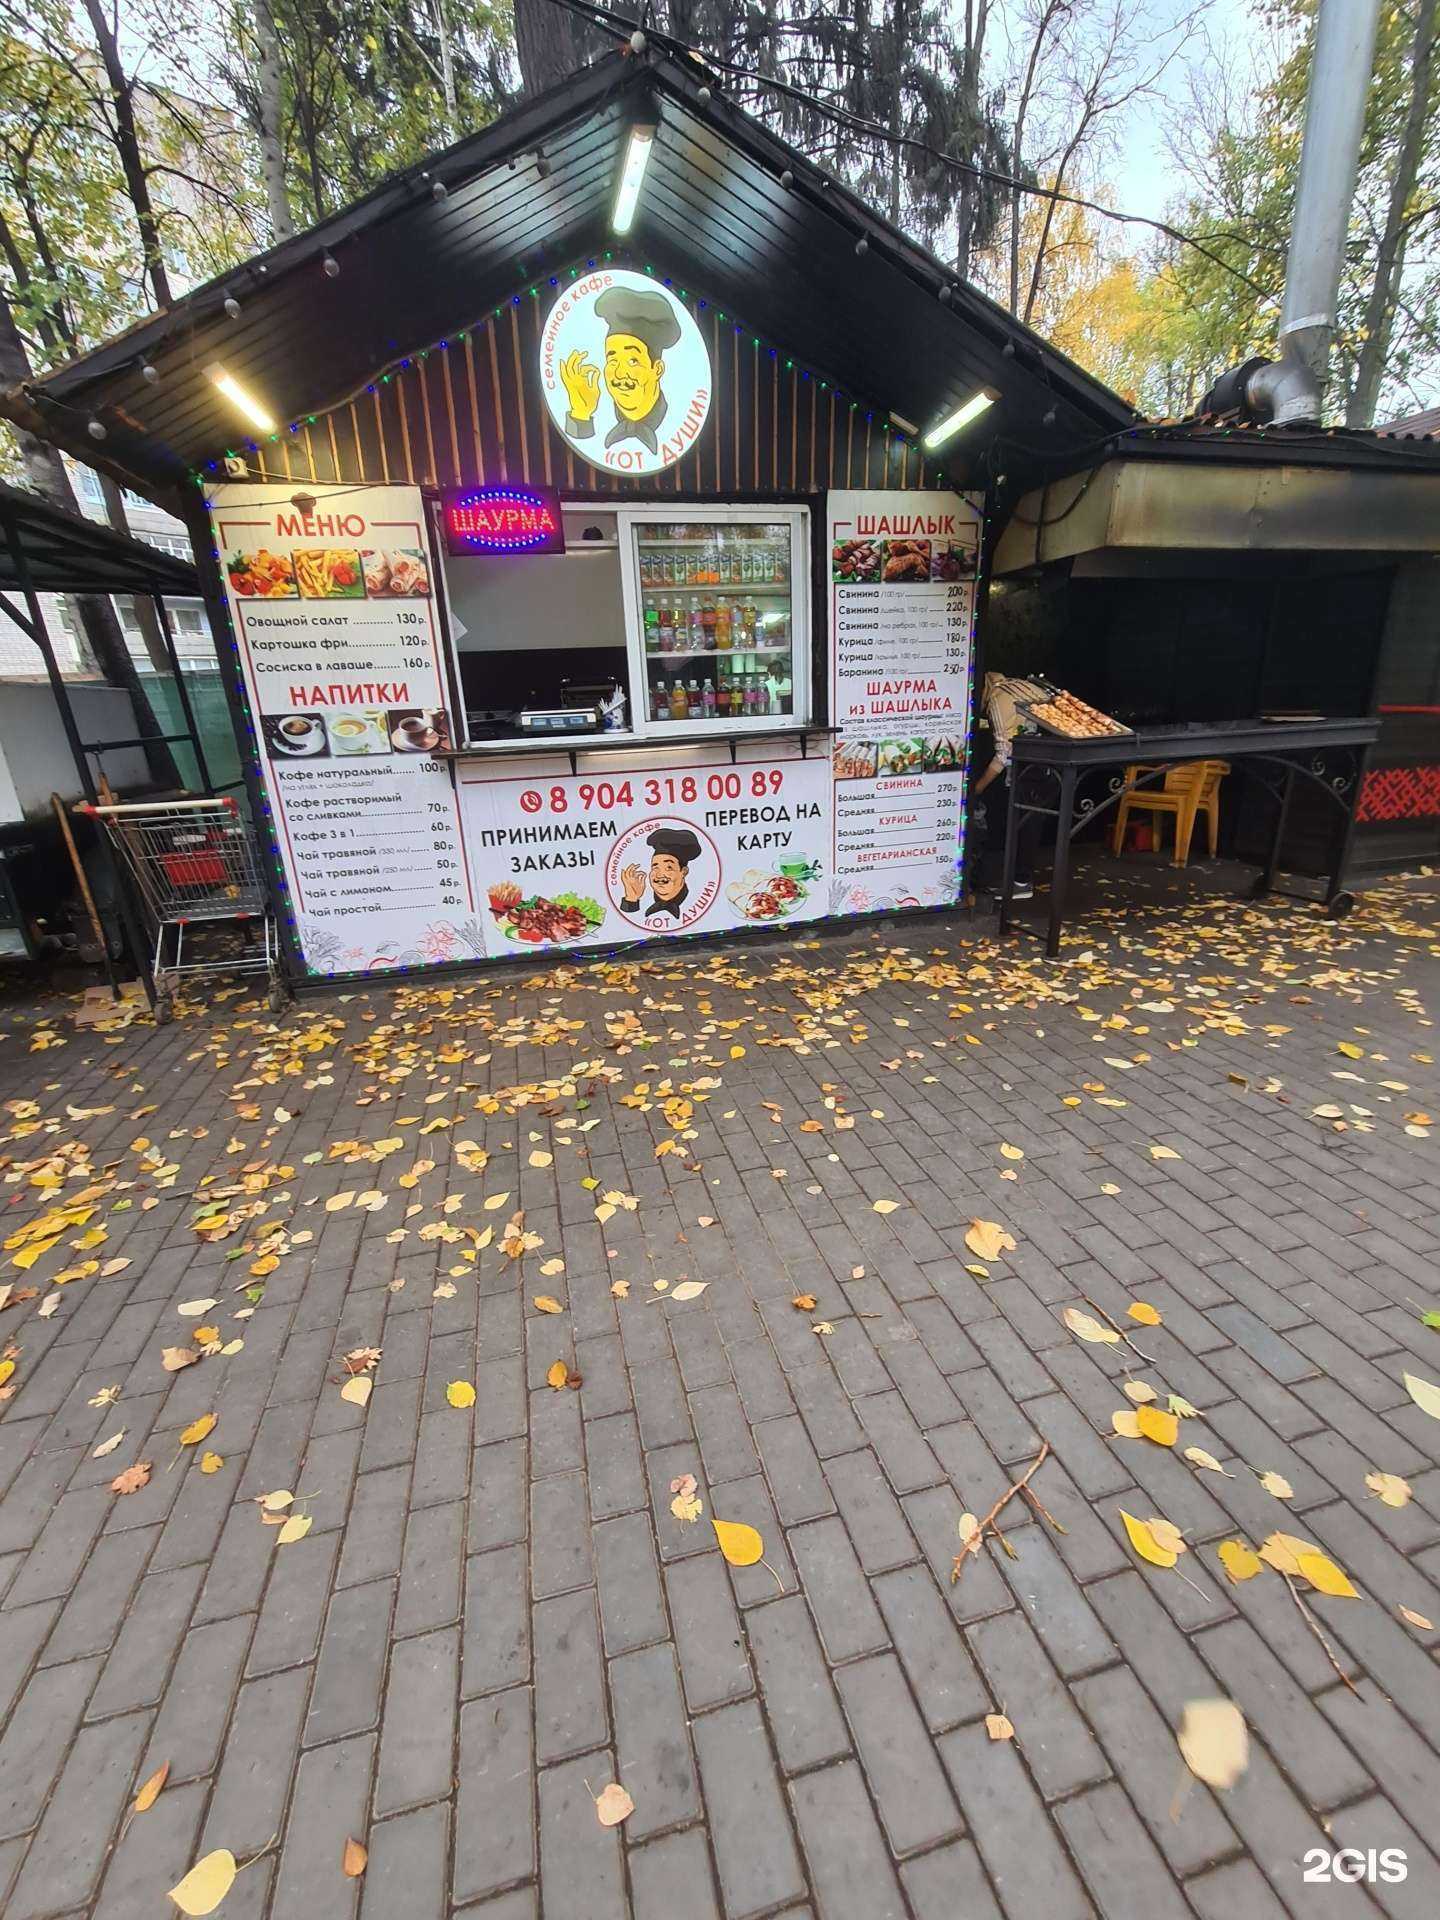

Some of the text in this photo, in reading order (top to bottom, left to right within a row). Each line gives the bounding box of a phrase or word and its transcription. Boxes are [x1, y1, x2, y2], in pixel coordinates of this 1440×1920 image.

[545, 275, 613, 389] семейное кафе
[277, 514, 364, 536] МЕНЮ
[453, 508, 554, 532] ШАУРМА
[858, 515, 954, 535] ШАШЛЫК
[838, 590, 879, 599] Свинина
[838, 606, 879, 614] Свинина
[247, 616, 308, 628] Овощной
[312, 616, 348, 625] салат
[838, 622, 878, 631] Свинина
[251, 640, 316, 652] Картошка
[321, 638, 348, 650] фри
[838, 638, 873, 647] Курица
[838, 654, 872, 663] Курица
[256, 662, 311, 672] Сосиска
[316, 663, 322, 671] в
[326, 660, 373, 671] лаваше
[838, 669, 883, 678] Баранина
[290, 682, 409, 706] НАПИТКИ
[867, 679, 936, 696] ШАУРМА
[871, 697, 952, 714] ШАШЛЫКА
[278, 770, 313, 781] Кофе
[317, 767, 392, 779] натуральный
[550, 770, 783, 813] 8 904 318 00 89
[876, 779, 923, 790] СВИНИНА
[286, 794, 402, 809] Кофе растворимый
[838, 794, 875, 802] Большая
[289, 814, 303, 822] со
[307, 810, 361, 821] сливками
[705, 803, 821, 827] ПЕРЕВОД НА
[838, 808, 875, 818] Средняя
[880, 815, 918, 825] КУРИЦА
[293, 830, 327, 842] Кофе
[330, 830, 336, 838] 3
[350, 829, 355, 837] 1
[481, 820, 617, 847] ПРИНИМАЕМ
[633, 822, 660, 838] кафе
[838, 829, 874, 837] Большая
[737, 832, 792, 851] КАРТУ
[838, 843, 874, 852] Средняя
[297, 850, 319, 861] Чай
[322, 847, 376, 860] травяной
[510, 850, 595, 872] ЗАКАЗЫ
[857, 847, 937, 862] ВЕГЕТАРИАНСКАЯ
[301, 869, 323, 880] Чай
[326, 866, 380, 879] травяной
[838, 866, 874, 875] Средняя
[305, 888, 326, 899] Чай
[341, 885, 391, 896] лимоном
[309, 907, 331, 918] Чай
[334, 903, 382, 916] простой
